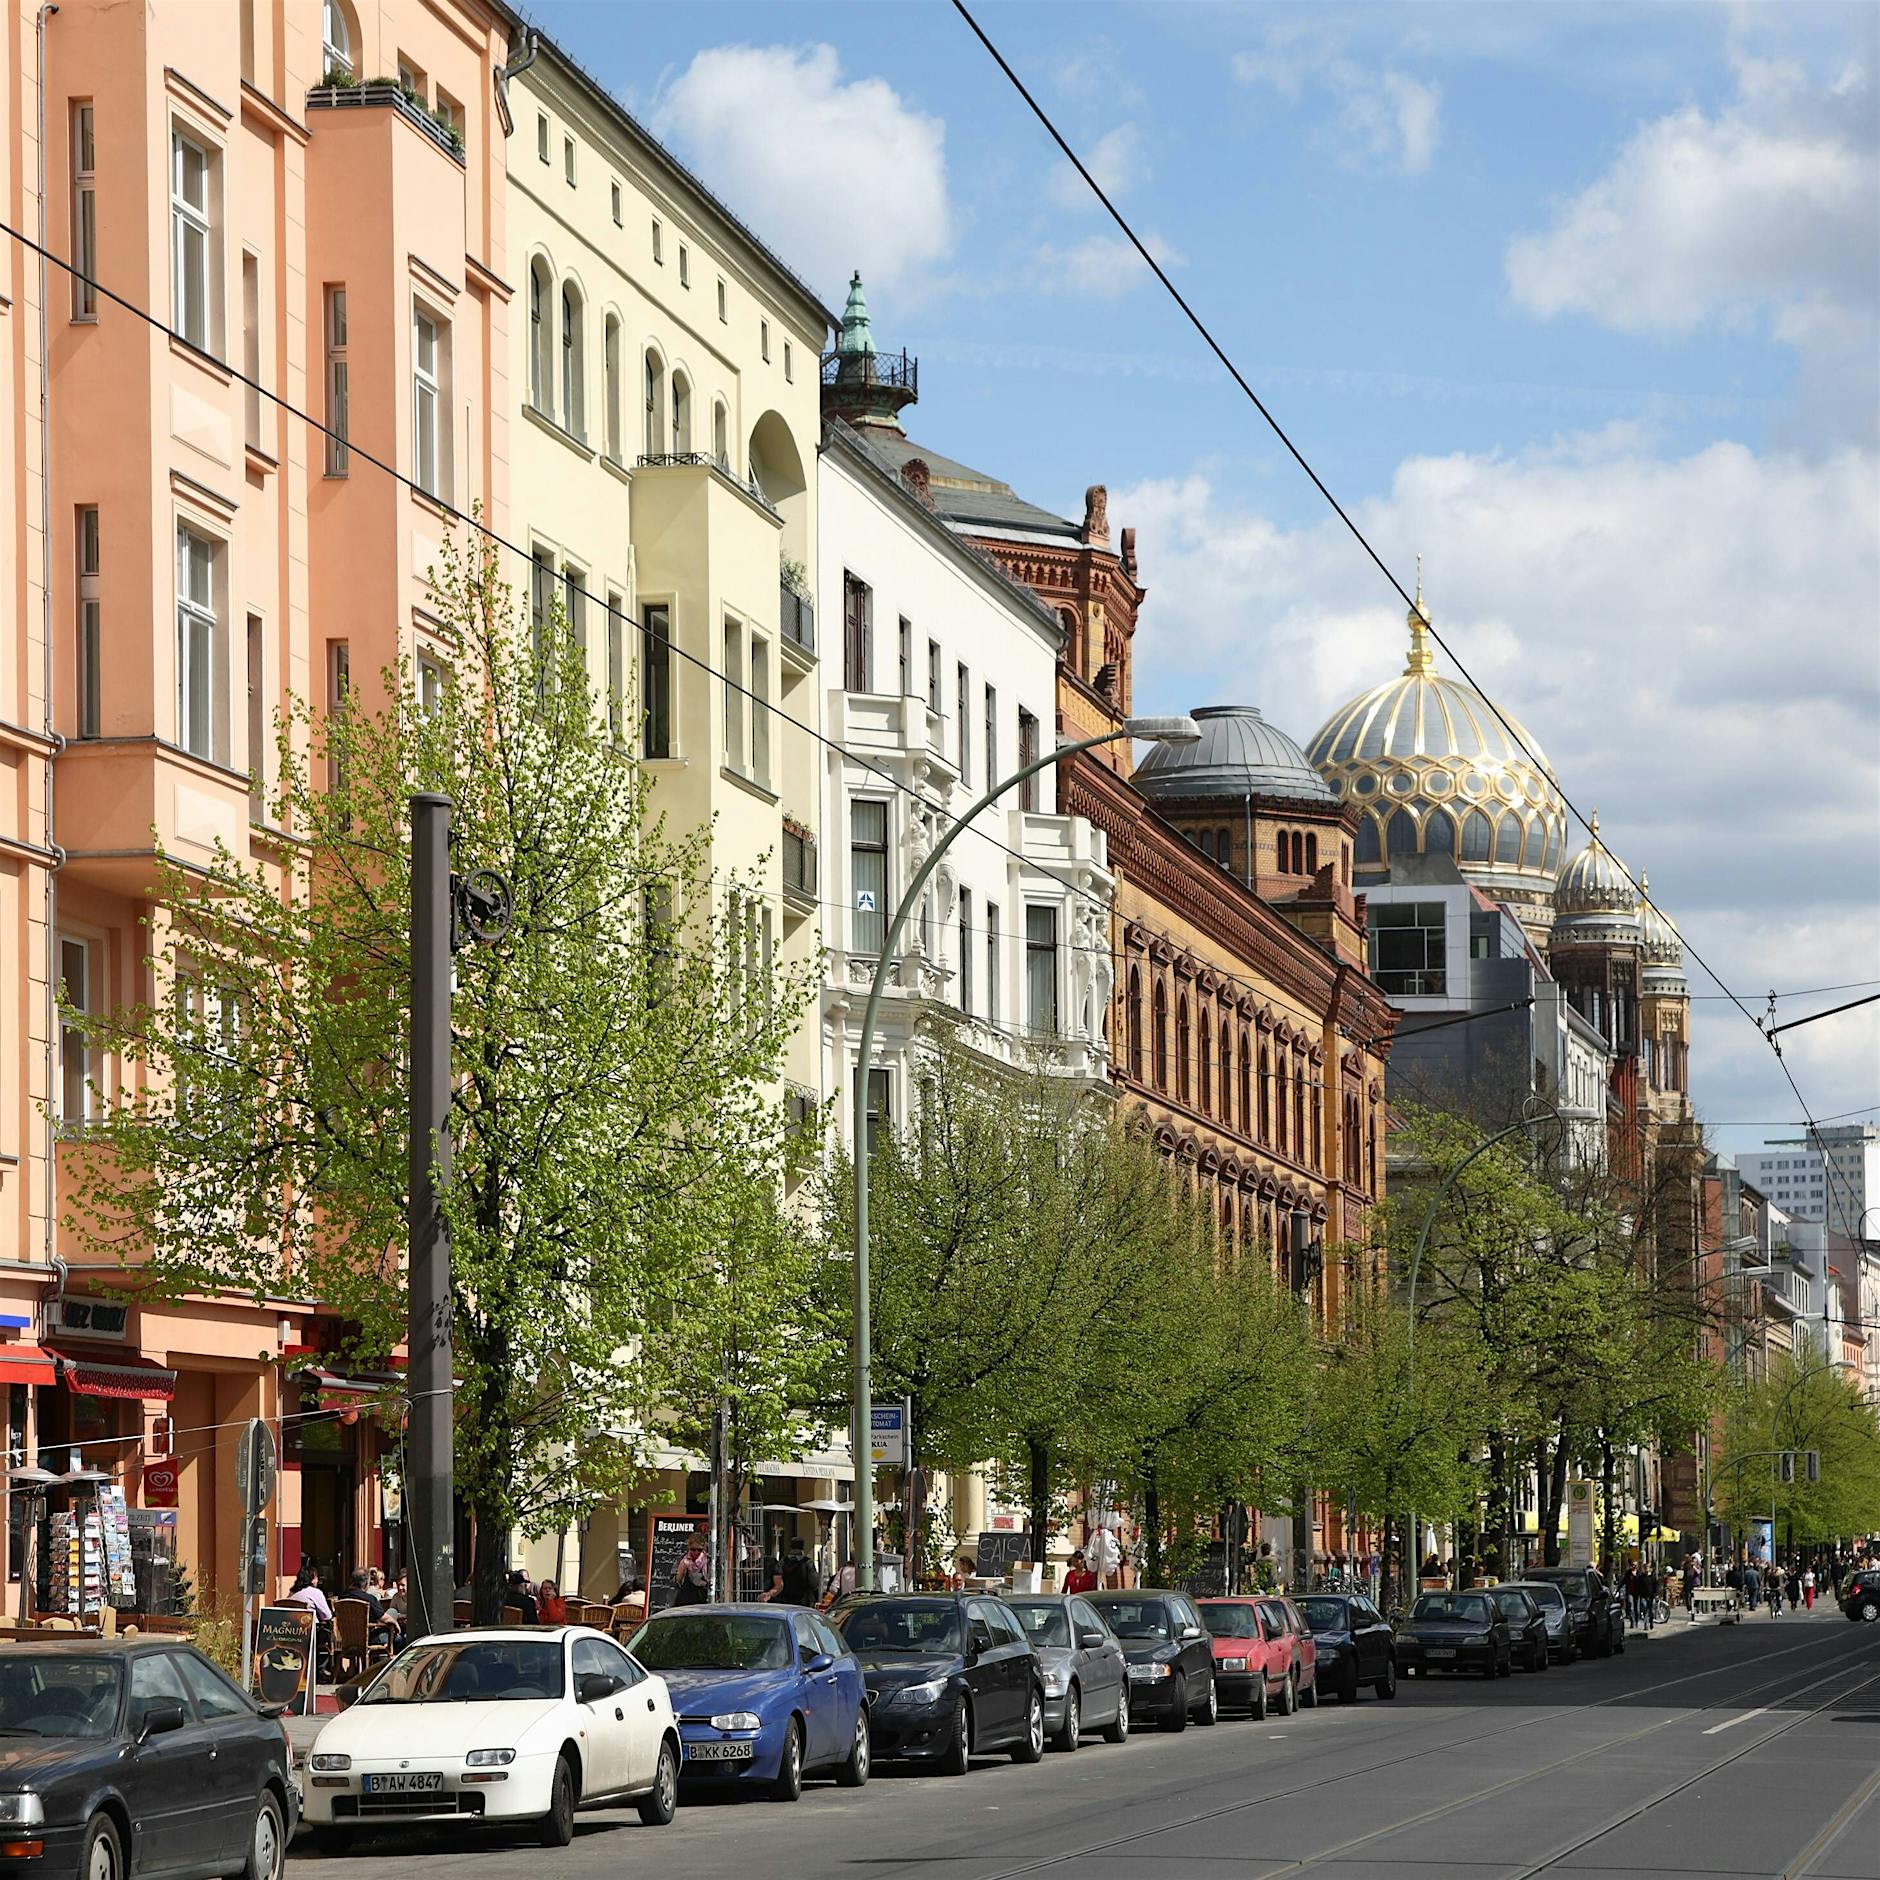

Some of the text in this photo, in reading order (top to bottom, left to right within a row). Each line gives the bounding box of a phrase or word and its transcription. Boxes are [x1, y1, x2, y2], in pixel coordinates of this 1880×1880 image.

[871, 1412, 899, 1420] KSCHEIN-
[658, 1520, 695, 1533] BERLINER
[262, 1624, 308, 1636] MAGNUM
[691, 1744, 750, 1759] B KK 6268
[371, 1775, 441, 1791] B AW 4847
